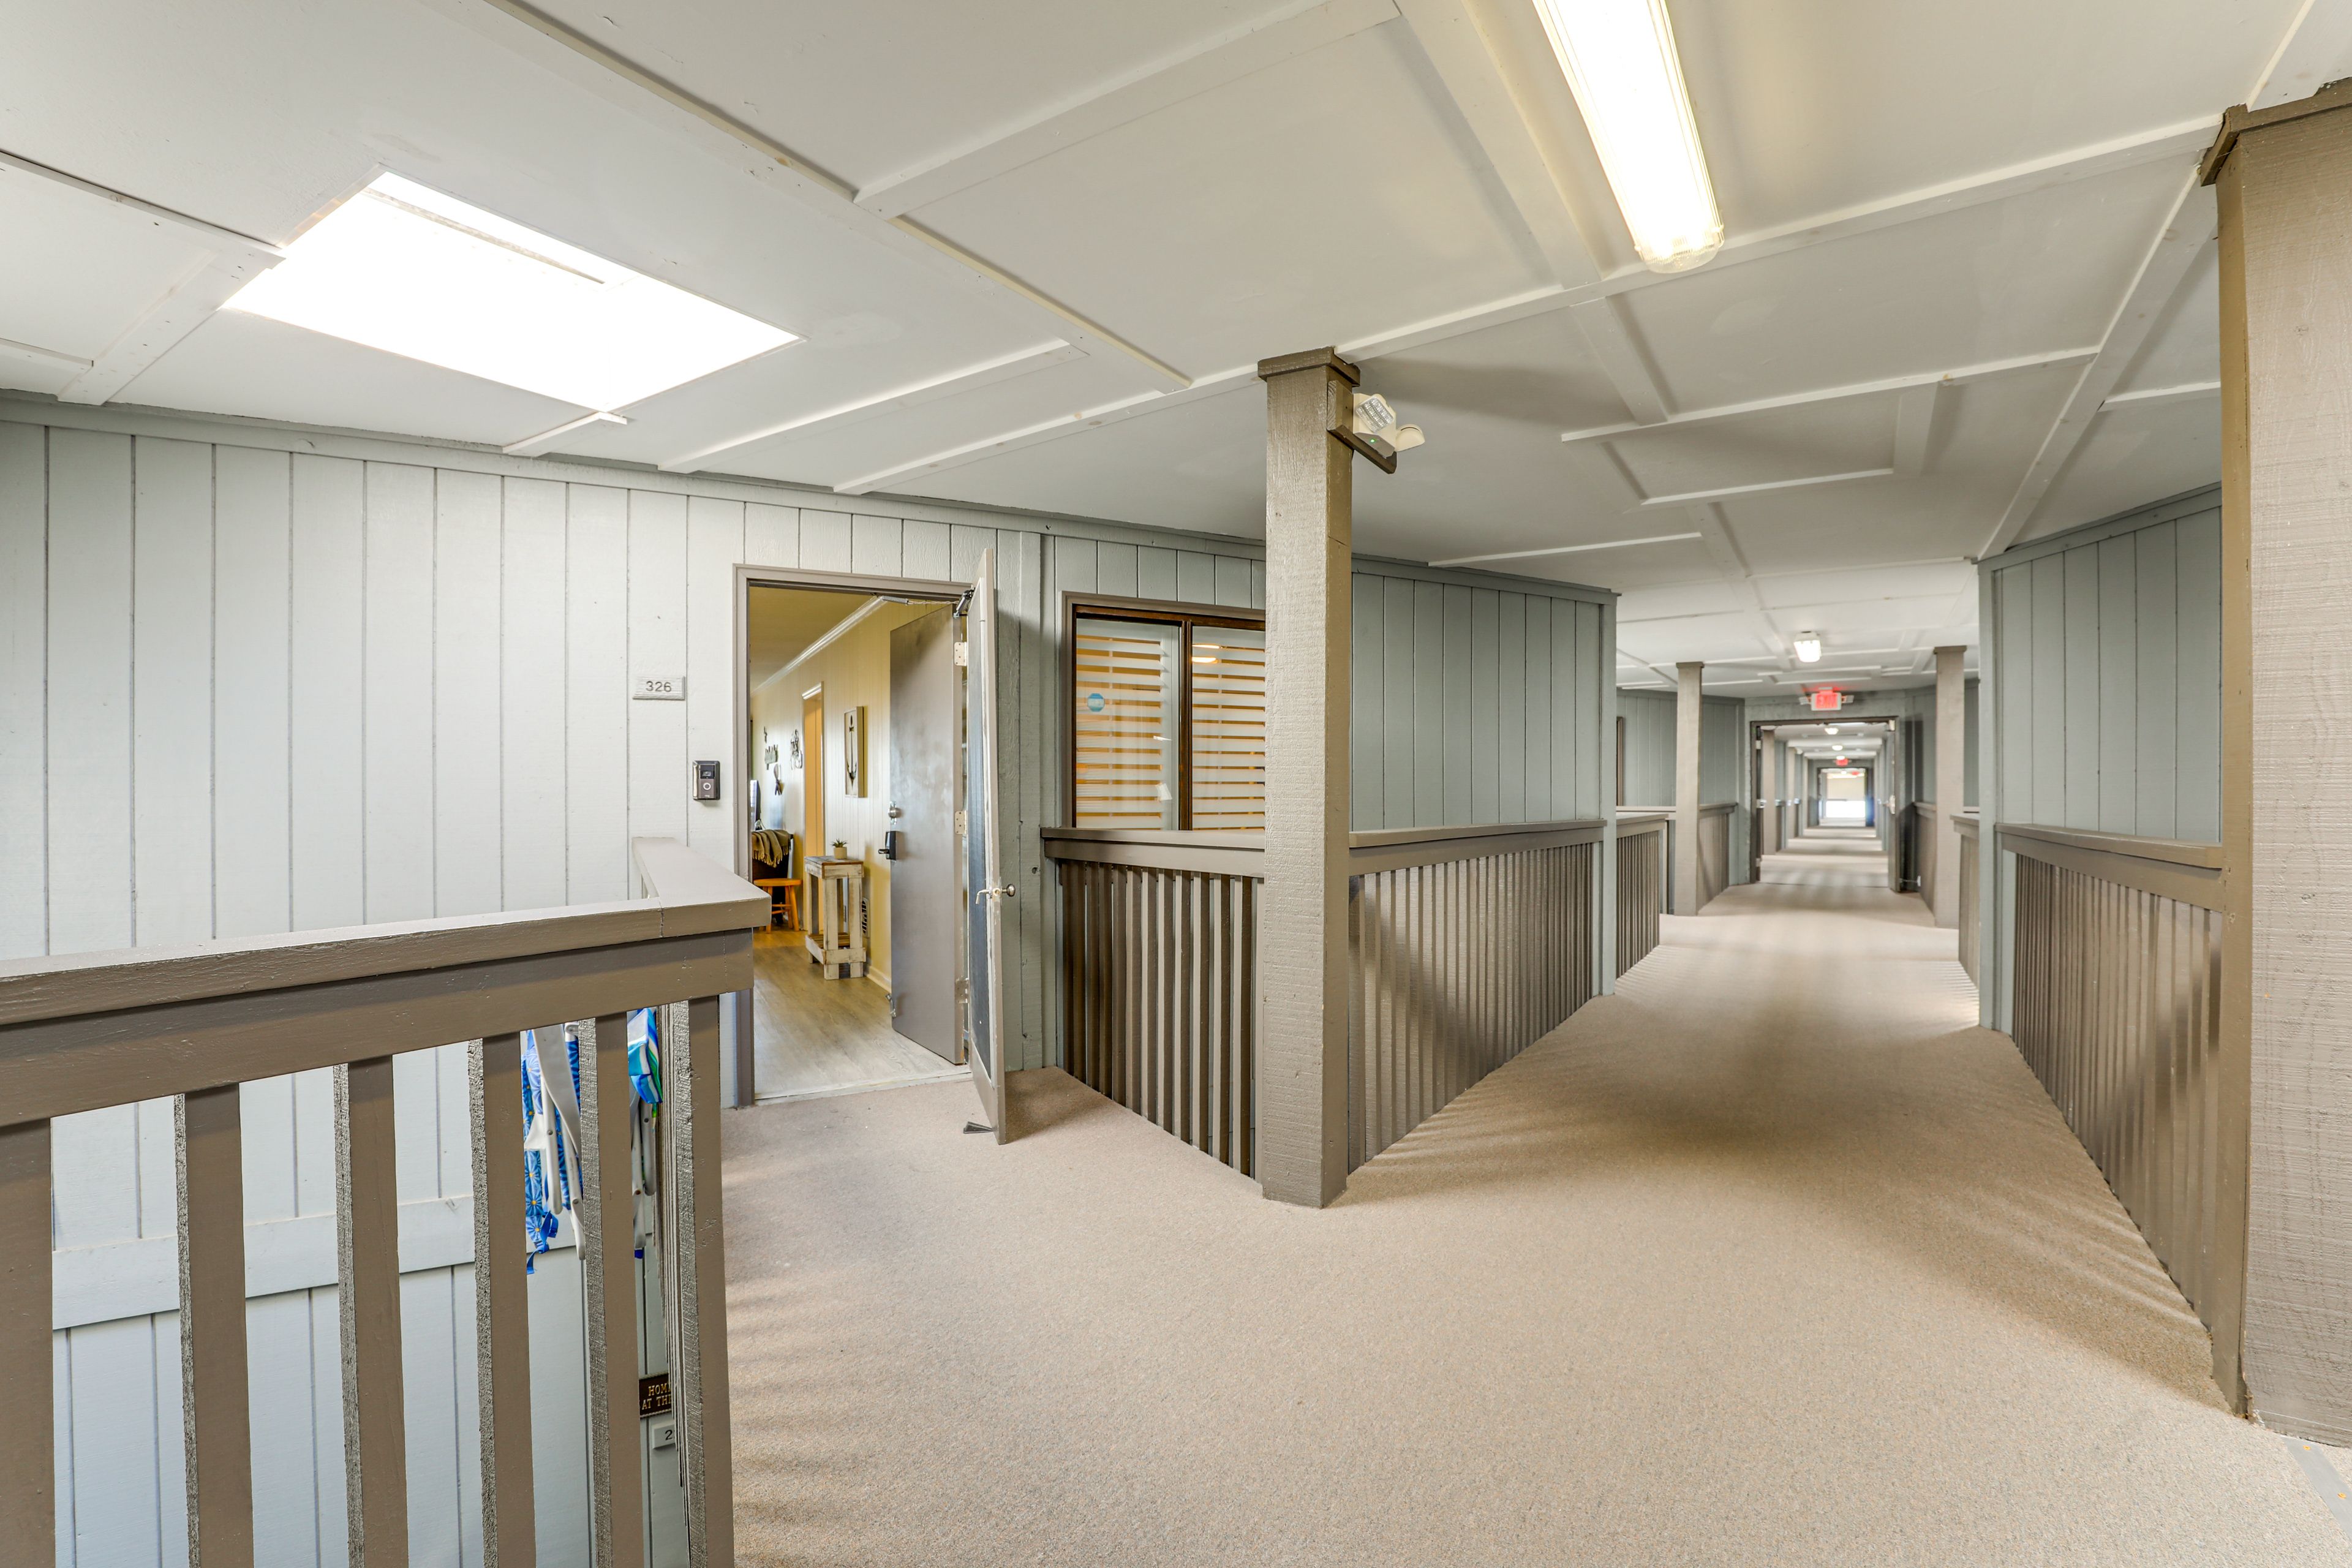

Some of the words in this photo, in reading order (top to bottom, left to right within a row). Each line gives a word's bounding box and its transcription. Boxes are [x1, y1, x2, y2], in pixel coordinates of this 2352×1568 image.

[646, 681, 672, 692] 326
[641, 1398, 652, 1410] AT
[665, 1430, 675, 1441] 2
